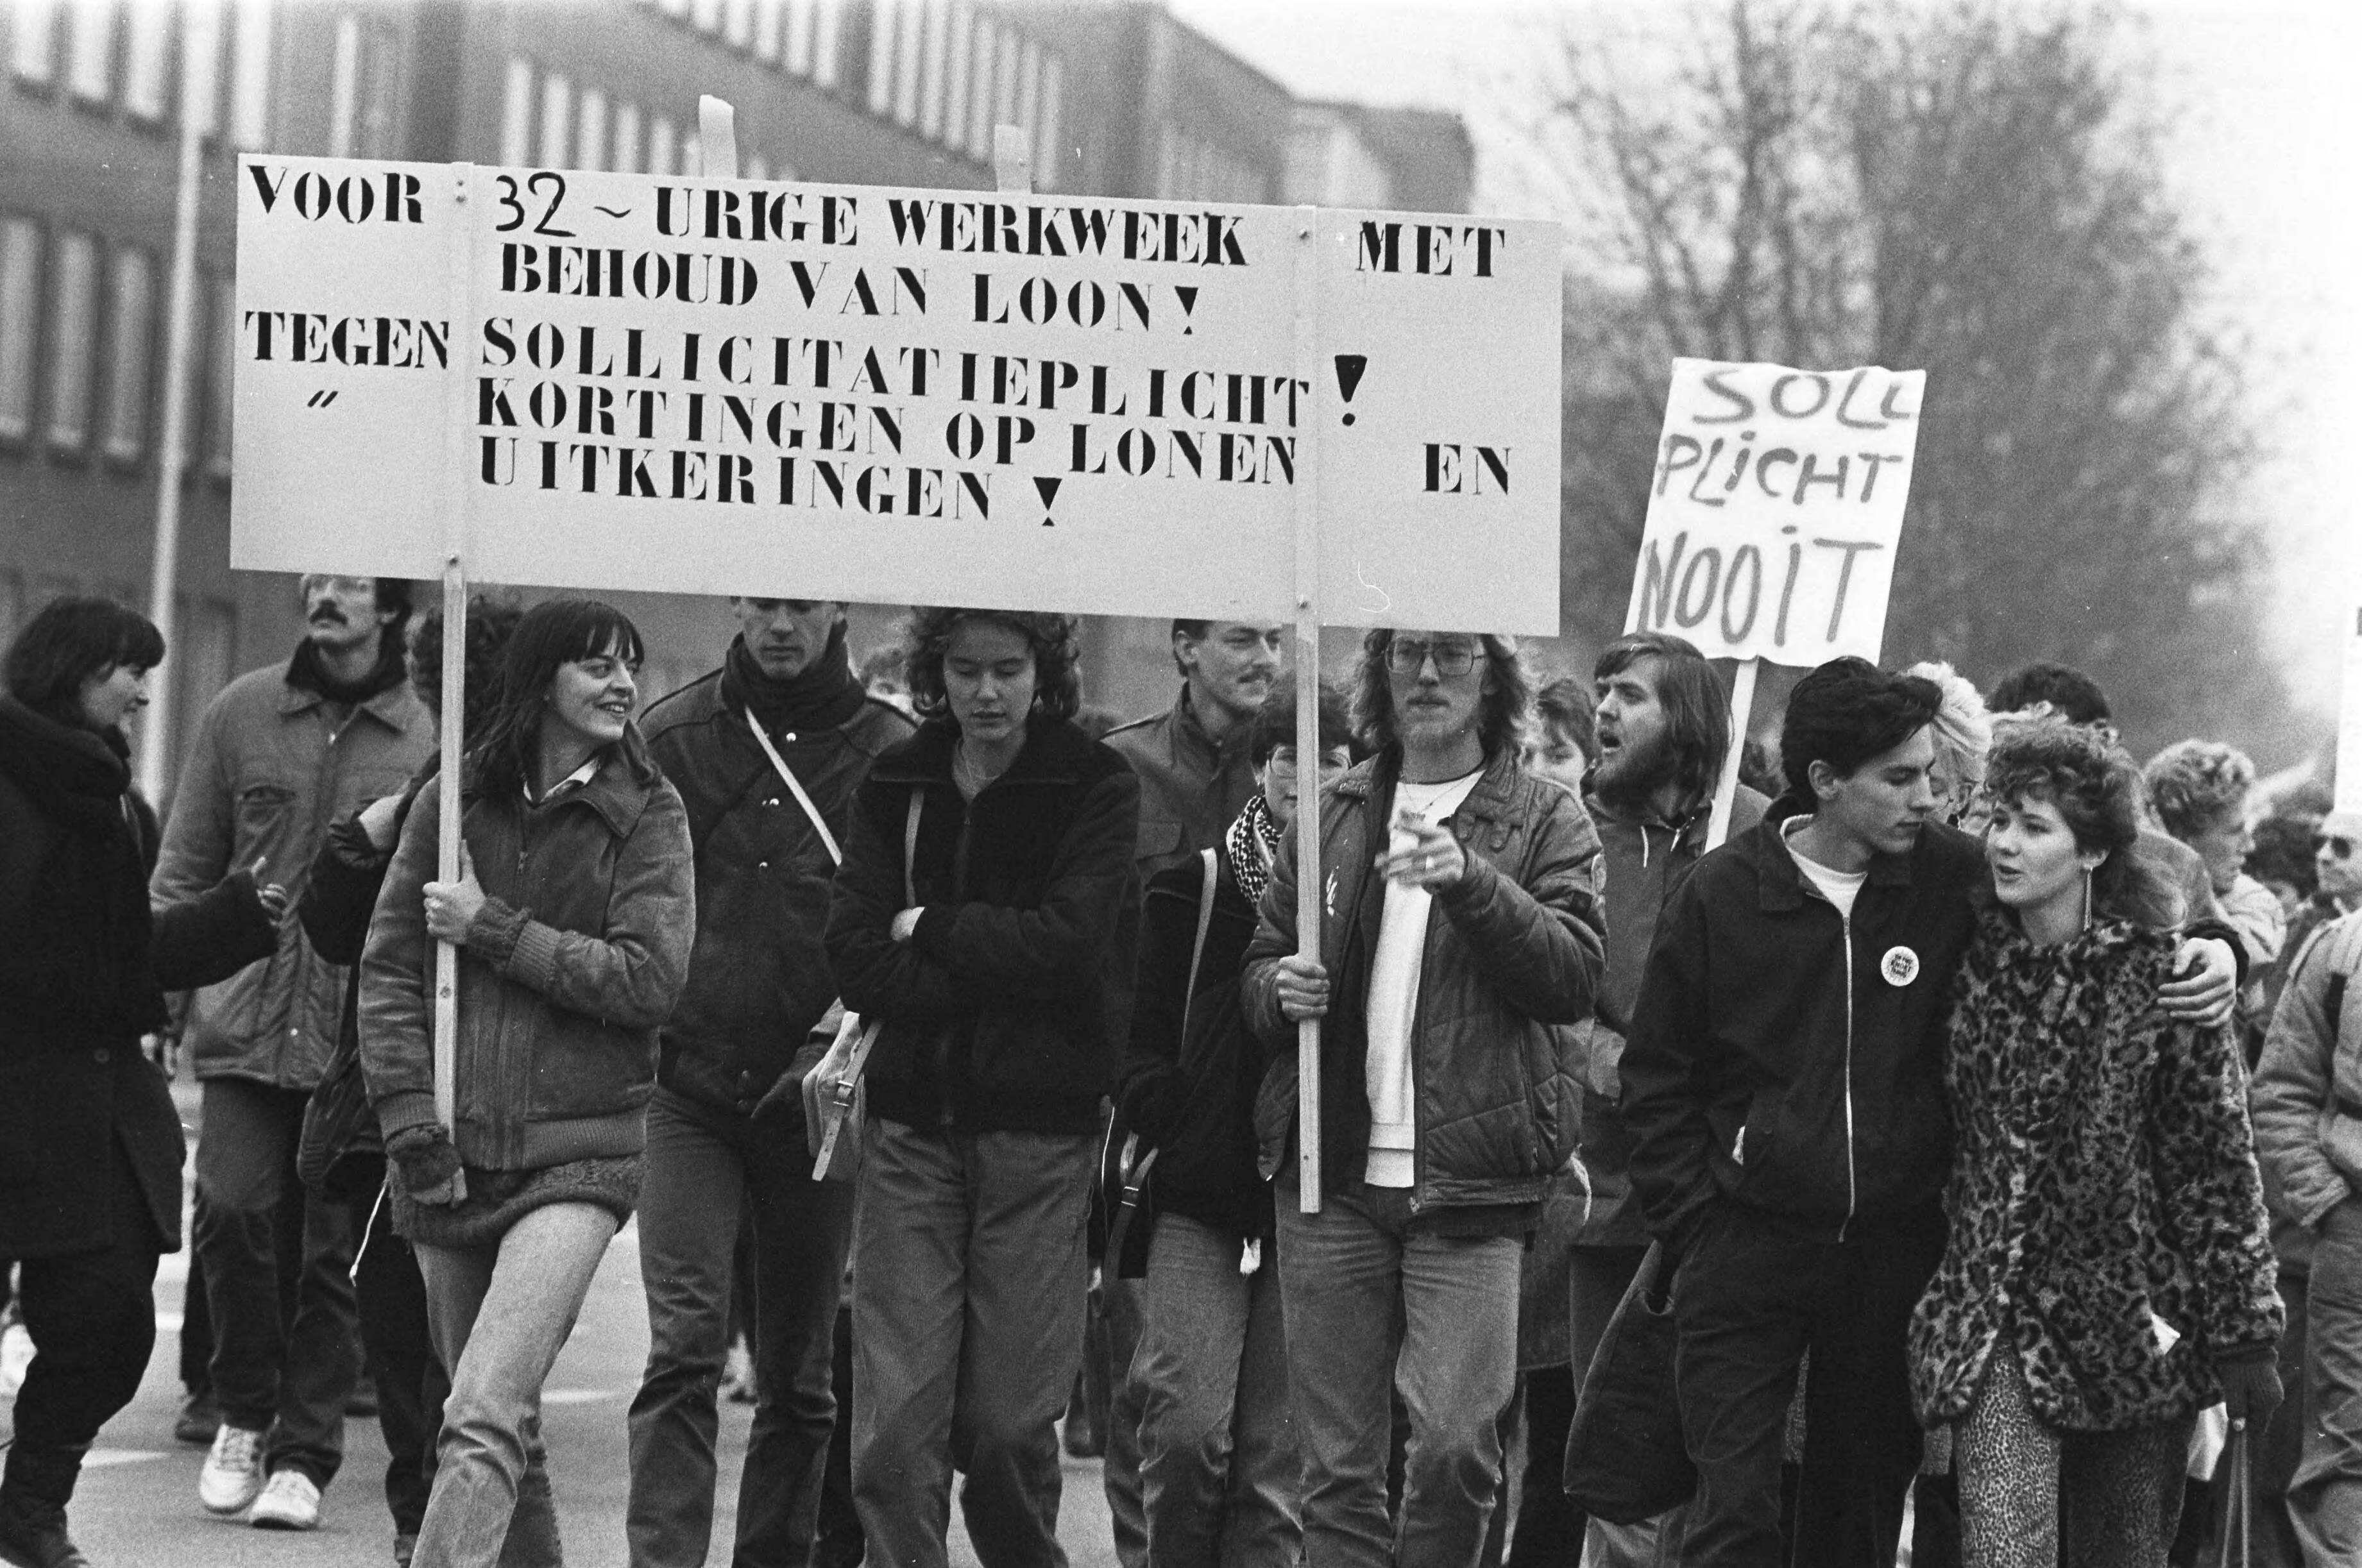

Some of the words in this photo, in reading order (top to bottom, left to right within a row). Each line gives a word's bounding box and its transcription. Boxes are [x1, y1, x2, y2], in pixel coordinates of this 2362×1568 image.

[247, 165, 423, 224] VOOR
[496, 171, 577, 238] 32
[654, 185, 858, 247] URIGE
[888, 198, 1251, 267] WERKWEEK
[1356, 221, 1506, 278] MET
[501, 242, 758, 307] BEHOUD
[789, 260, 930, 317] VAN
[244, 310, 450, 371] TEGEN
[482, 317, 1313, 429] SOLLICITATIEPLICHT
[1692, 367, 1920, 430] SOLL
[477, 377, 903, 455] KORTINGEN
[946, 412, 1037, 464] OP
[1071, 422, 1298, 486] LONEN
[1424, 443, 1511, 494] EN
[479, 435, 993, 521] UITKERINGEN
